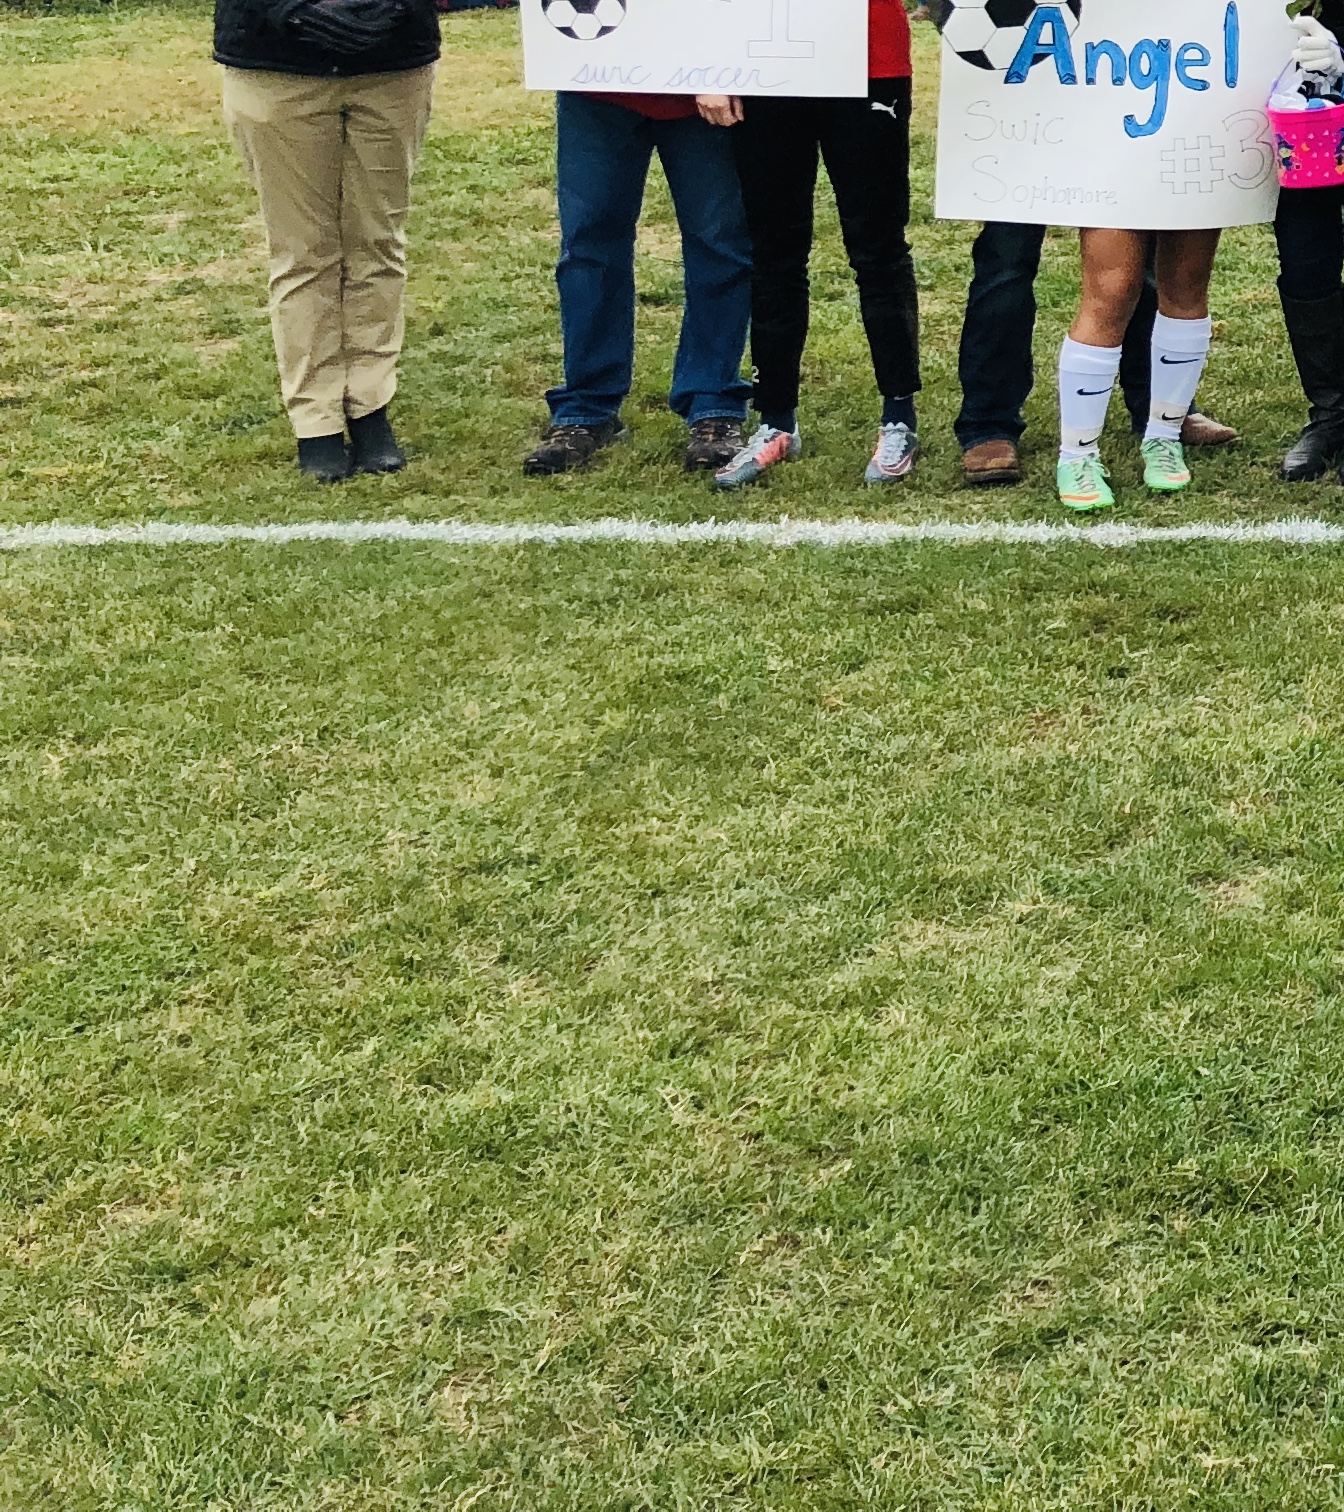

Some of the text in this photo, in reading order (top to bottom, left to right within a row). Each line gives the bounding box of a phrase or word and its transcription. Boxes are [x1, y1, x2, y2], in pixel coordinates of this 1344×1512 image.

[662, 66, 791, 89] soccer
[1003, 0, 1241, 138] Angel
[971, 154, 1118, 209] Sophomore
[1160, 108, 1275, 195] #3
